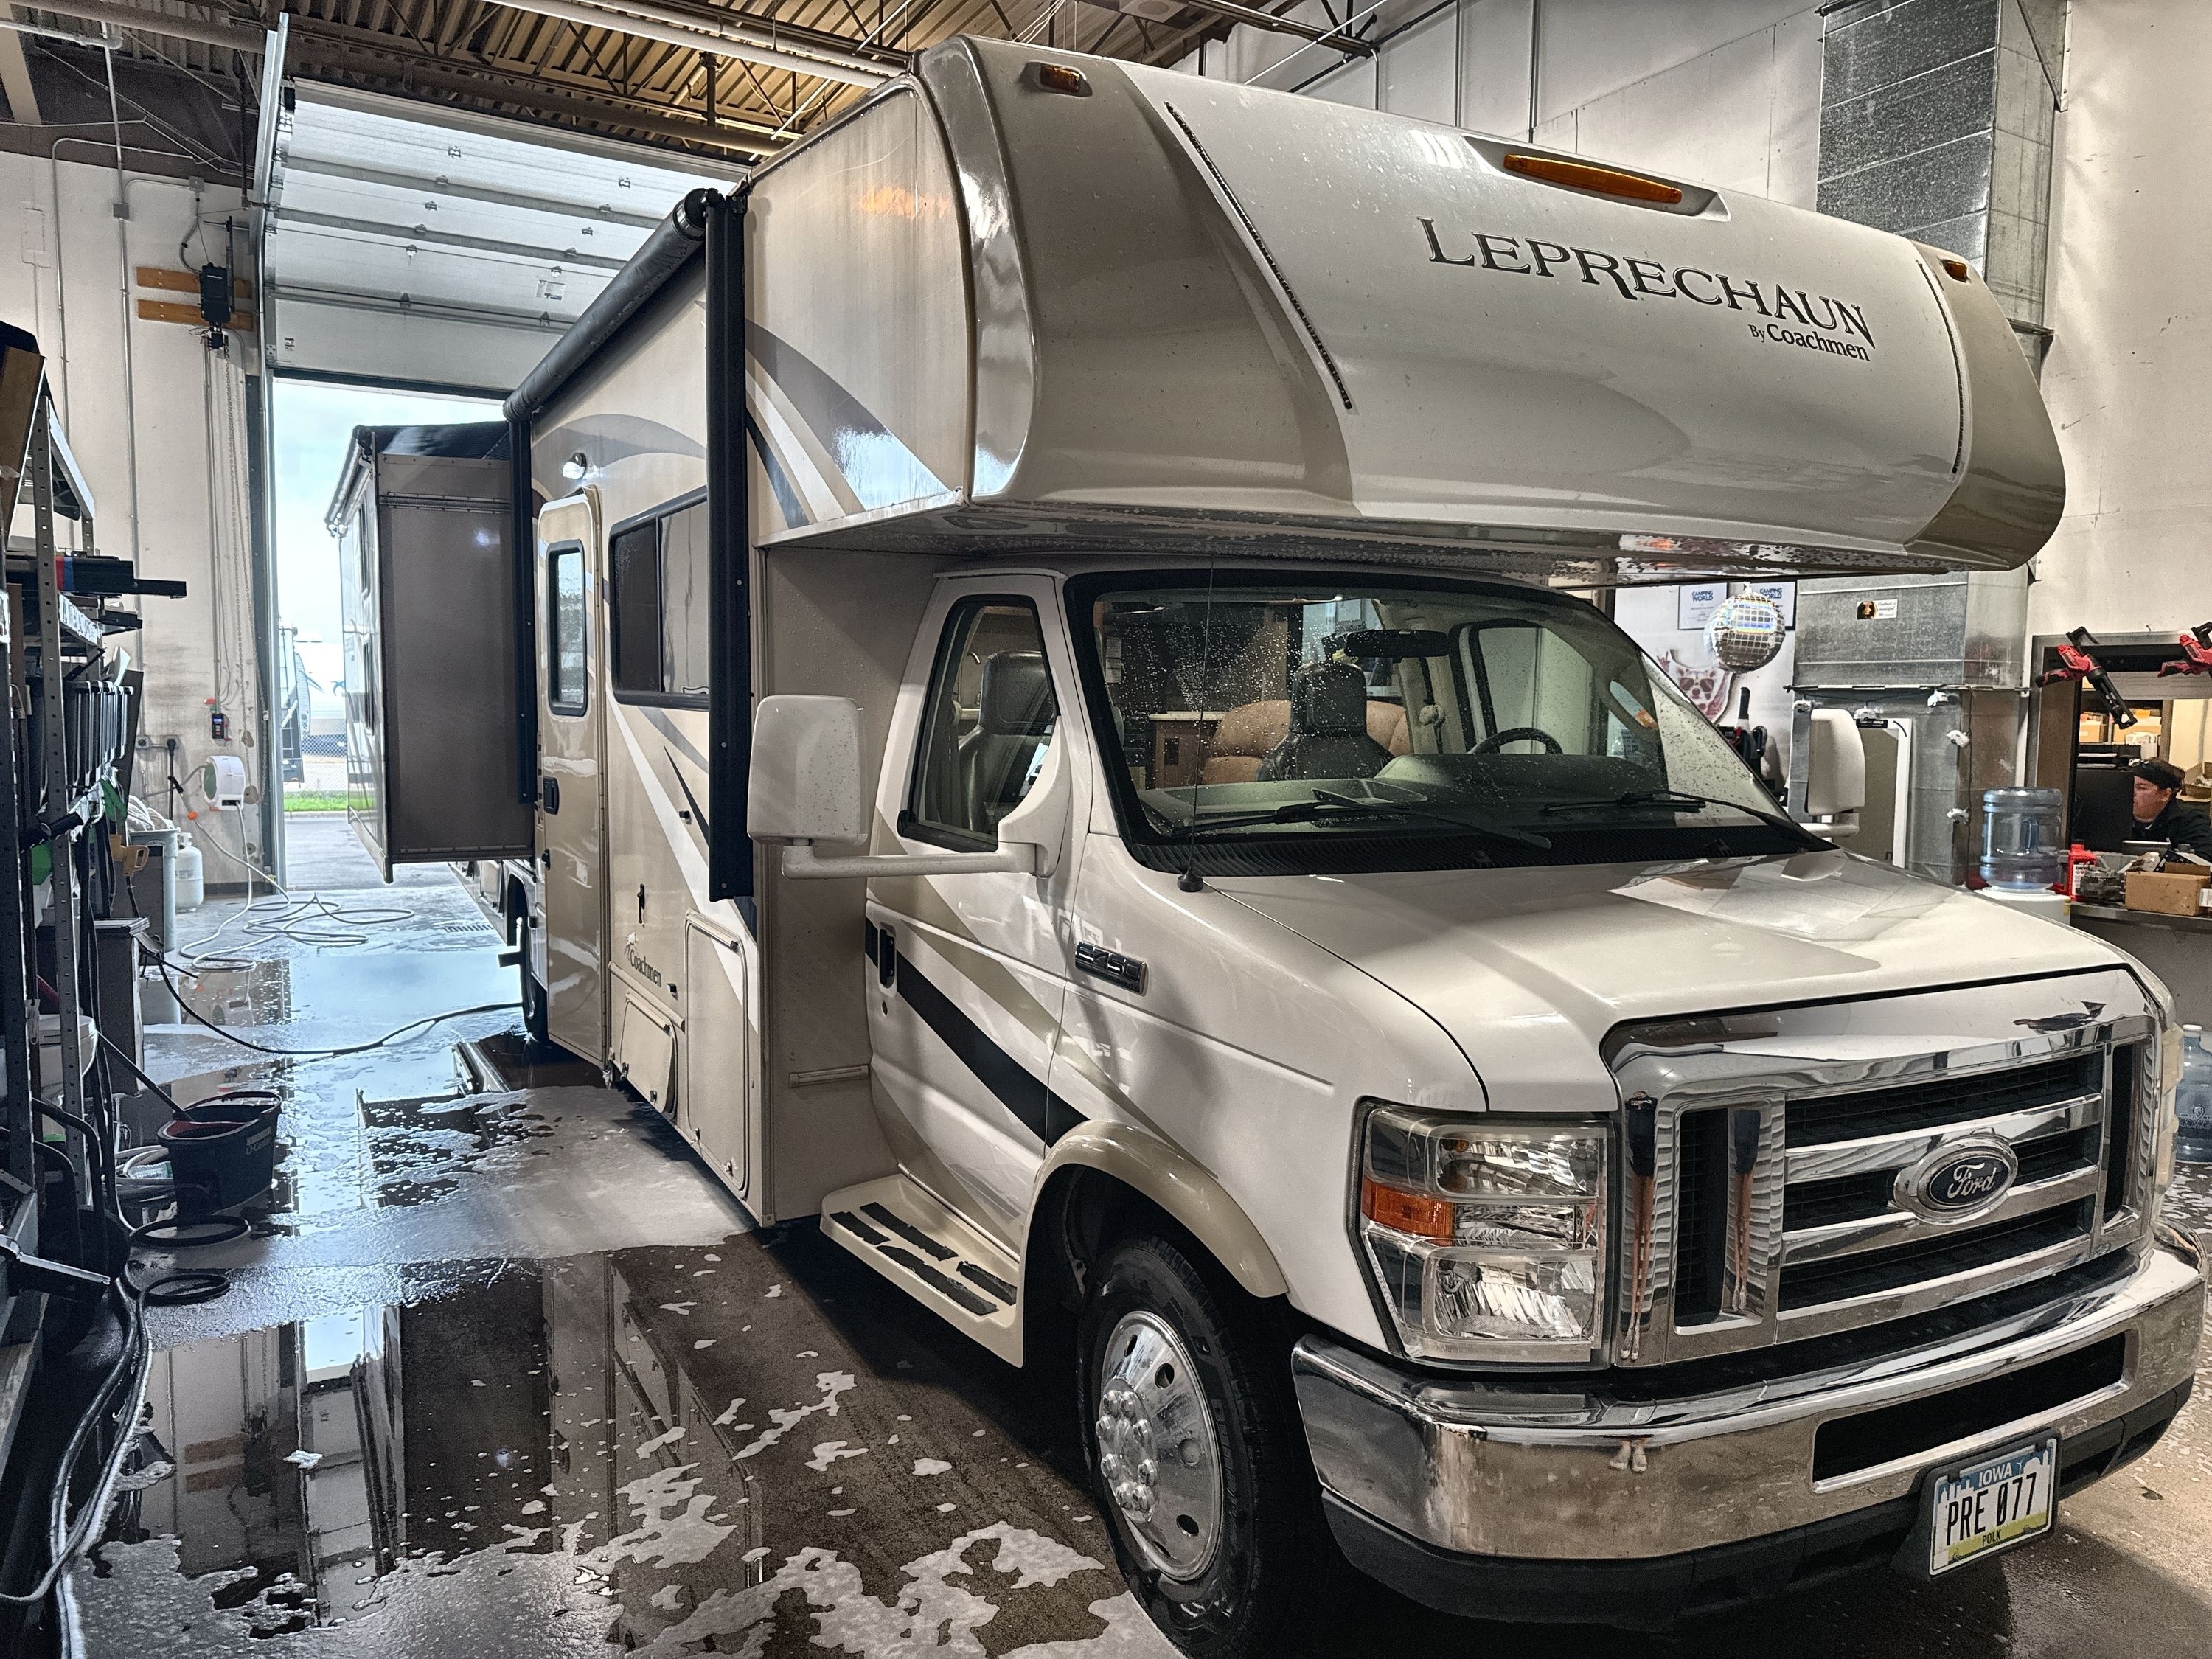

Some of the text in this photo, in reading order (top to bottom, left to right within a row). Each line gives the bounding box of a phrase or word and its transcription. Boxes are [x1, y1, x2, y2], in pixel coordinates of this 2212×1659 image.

[1416, 216, 1876, 349] LEPRECHAUN
[1747, 323, 1871, 362] By Coachmen
[630, 949, 662, 989] Coachmen
[1947, 1162, 1997, 1199] Ford
[1978, 1462, 2013, 1489] IOWA
[1946, 1472, 2037, 1546] PRE 077
[1982, 1528, 2002, 1546] POLK
